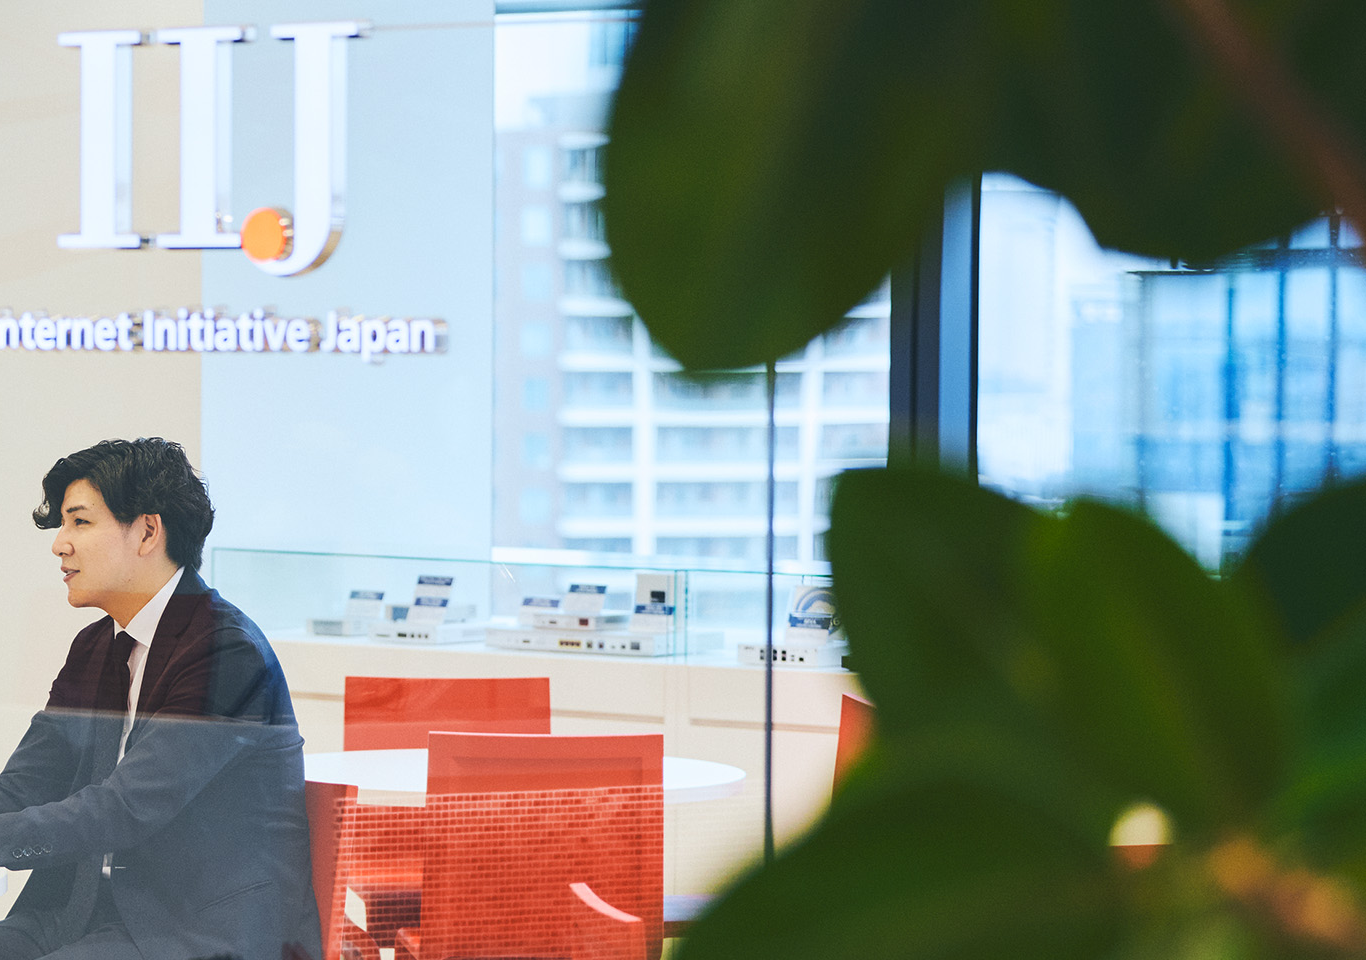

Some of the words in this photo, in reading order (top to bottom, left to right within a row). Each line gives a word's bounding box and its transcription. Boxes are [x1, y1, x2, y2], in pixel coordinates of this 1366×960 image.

[57, 20, 364, 277] IIJ
[142, 307, 311, 352] Initiative
[319, 310, 437, 363] Japan
